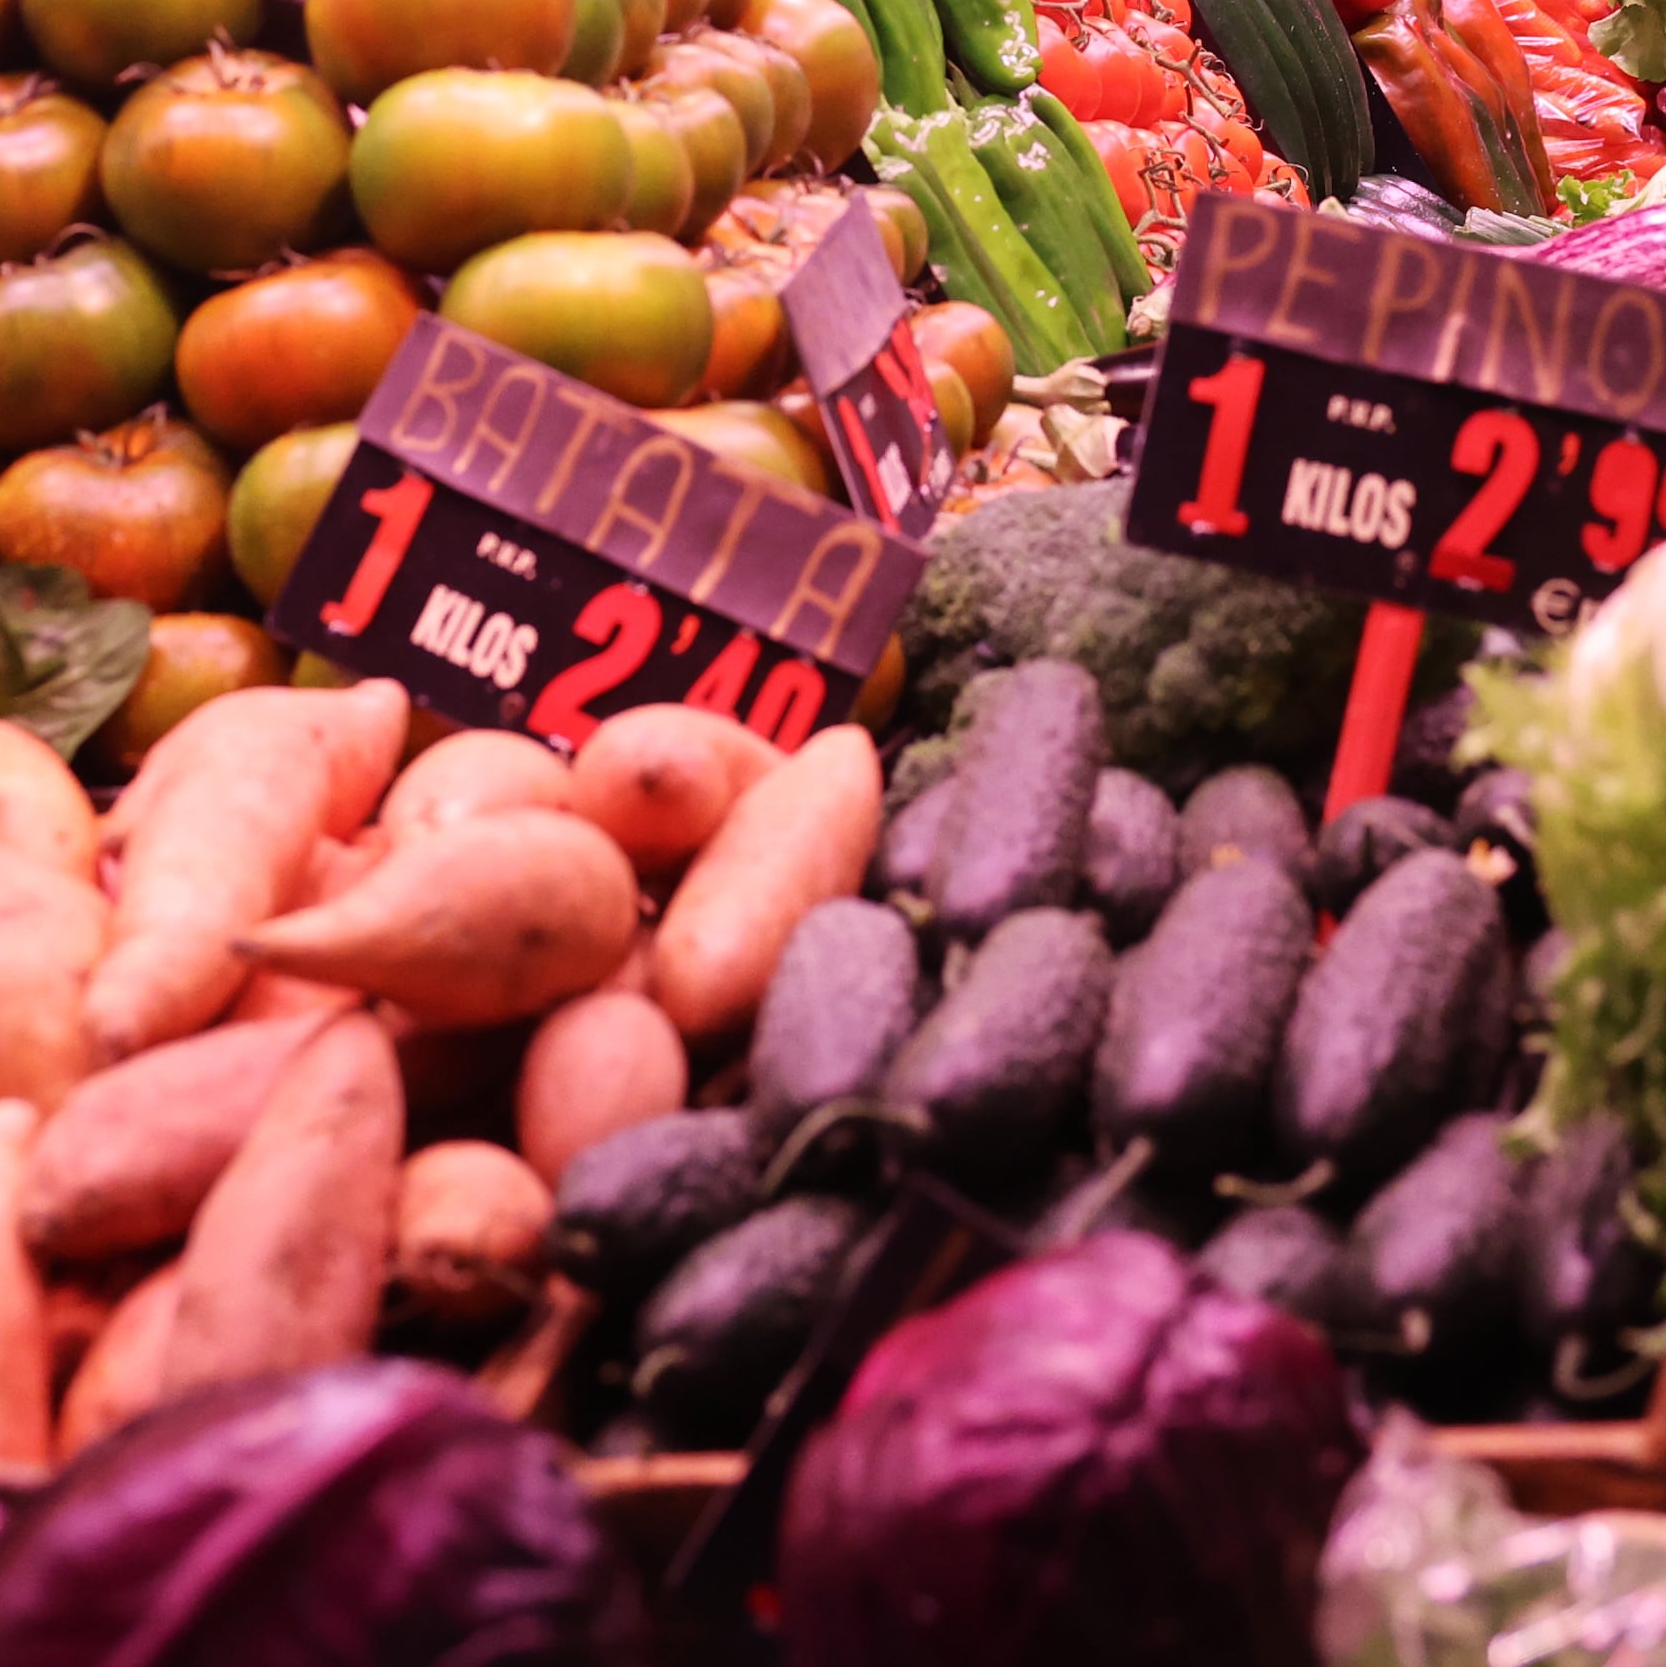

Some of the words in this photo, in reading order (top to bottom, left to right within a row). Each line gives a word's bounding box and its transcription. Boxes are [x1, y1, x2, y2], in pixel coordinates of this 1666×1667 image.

[389, 330, 884, 664] BATATA
[1176, 354, 1266, 536] 1
[1280, 456, 1418, 550] KILOS
[319, 471, 436, 636] 1
[409, 583, 540, 690] KILOS
